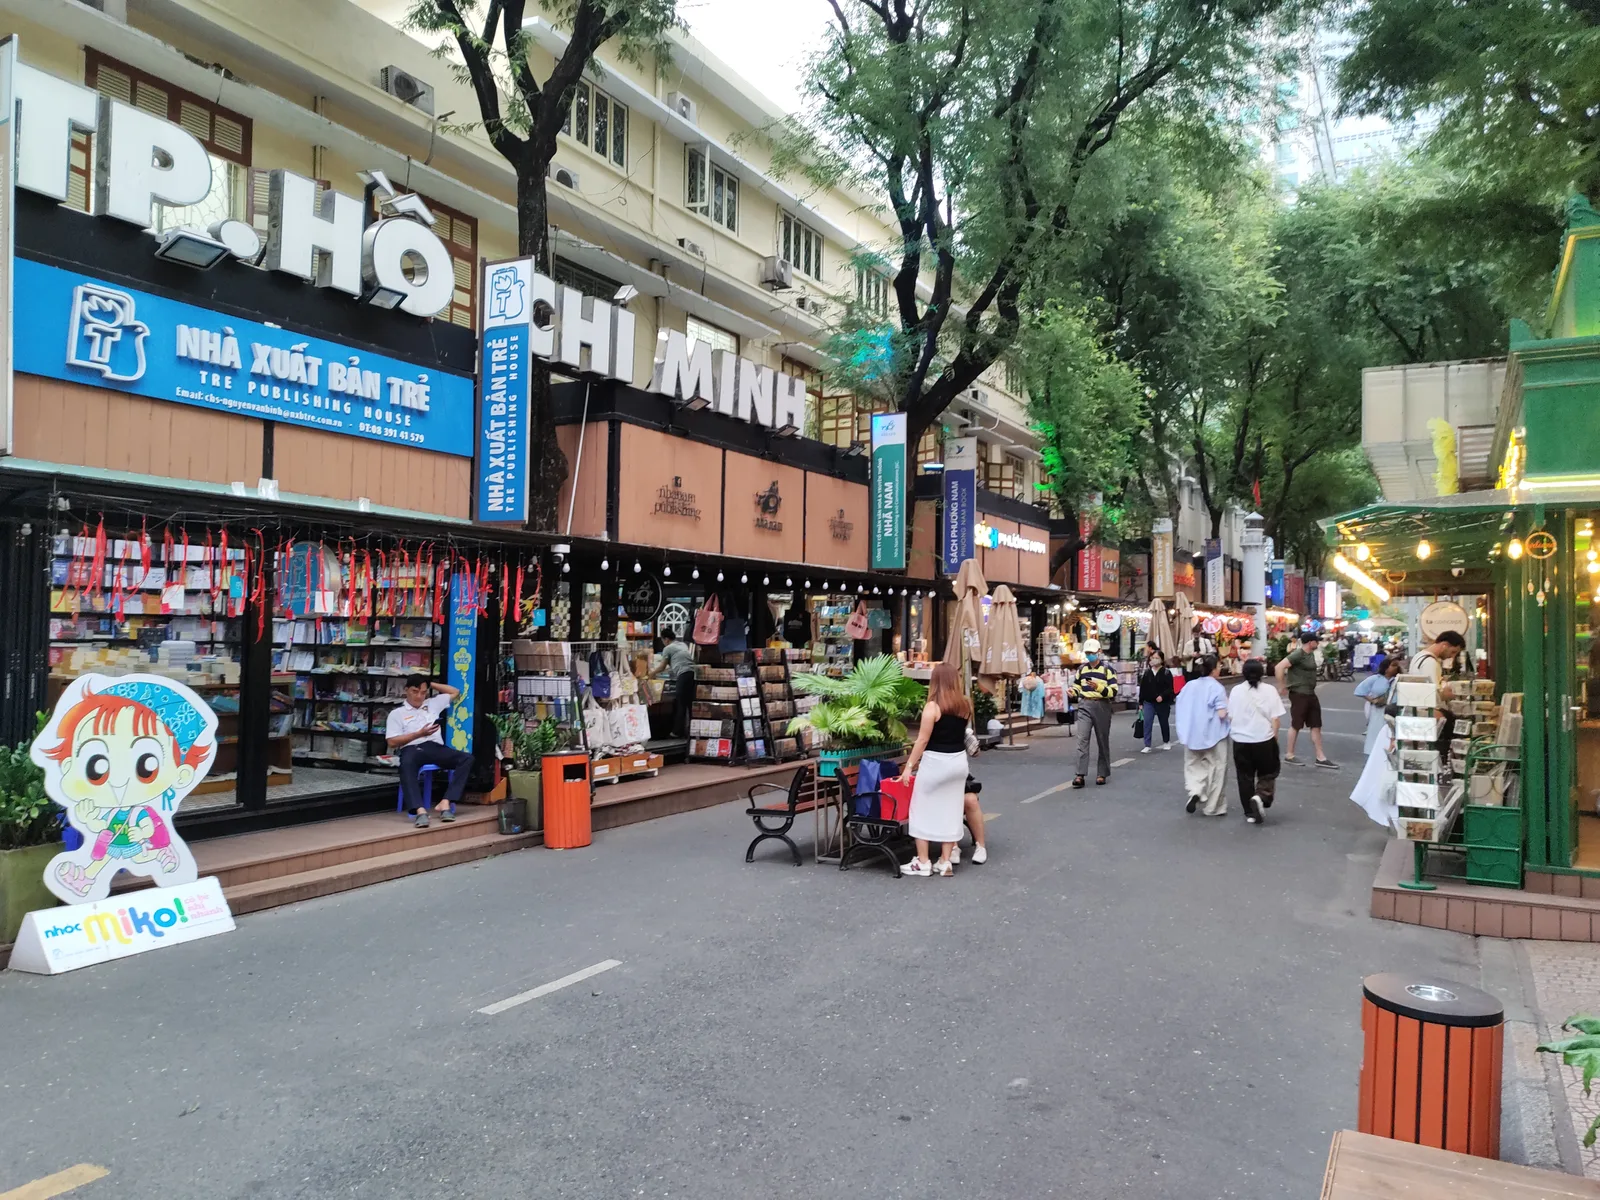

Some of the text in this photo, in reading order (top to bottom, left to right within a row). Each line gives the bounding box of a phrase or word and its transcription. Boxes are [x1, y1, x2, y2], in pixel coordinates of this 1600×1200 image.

[268, 168, 455, 317] HỒ
[176, 324, 431, 411] NHÀ XUẤT BẢN TRẺ
[650, 327, 806, 438] MINH
[199, 370, 411, 426] TRE PUBLISHING HOUSE
[485, 338, 508, 511] NHÀ XUẤT BẢN TRẺ
[505, 335, 519, 512] TRE PUBLISHING HOUSE
[383, 427, 397, 438] 391
[399, 430, 408, 440] 41
[410, 433, 425, 443] 579
[882, 481, 893, 537] NHÃ NAM
[951, 481, 959, 501] NAM
[949, 539, 958, 564] SÁCH
[83, 898, 188, 945] miko!
